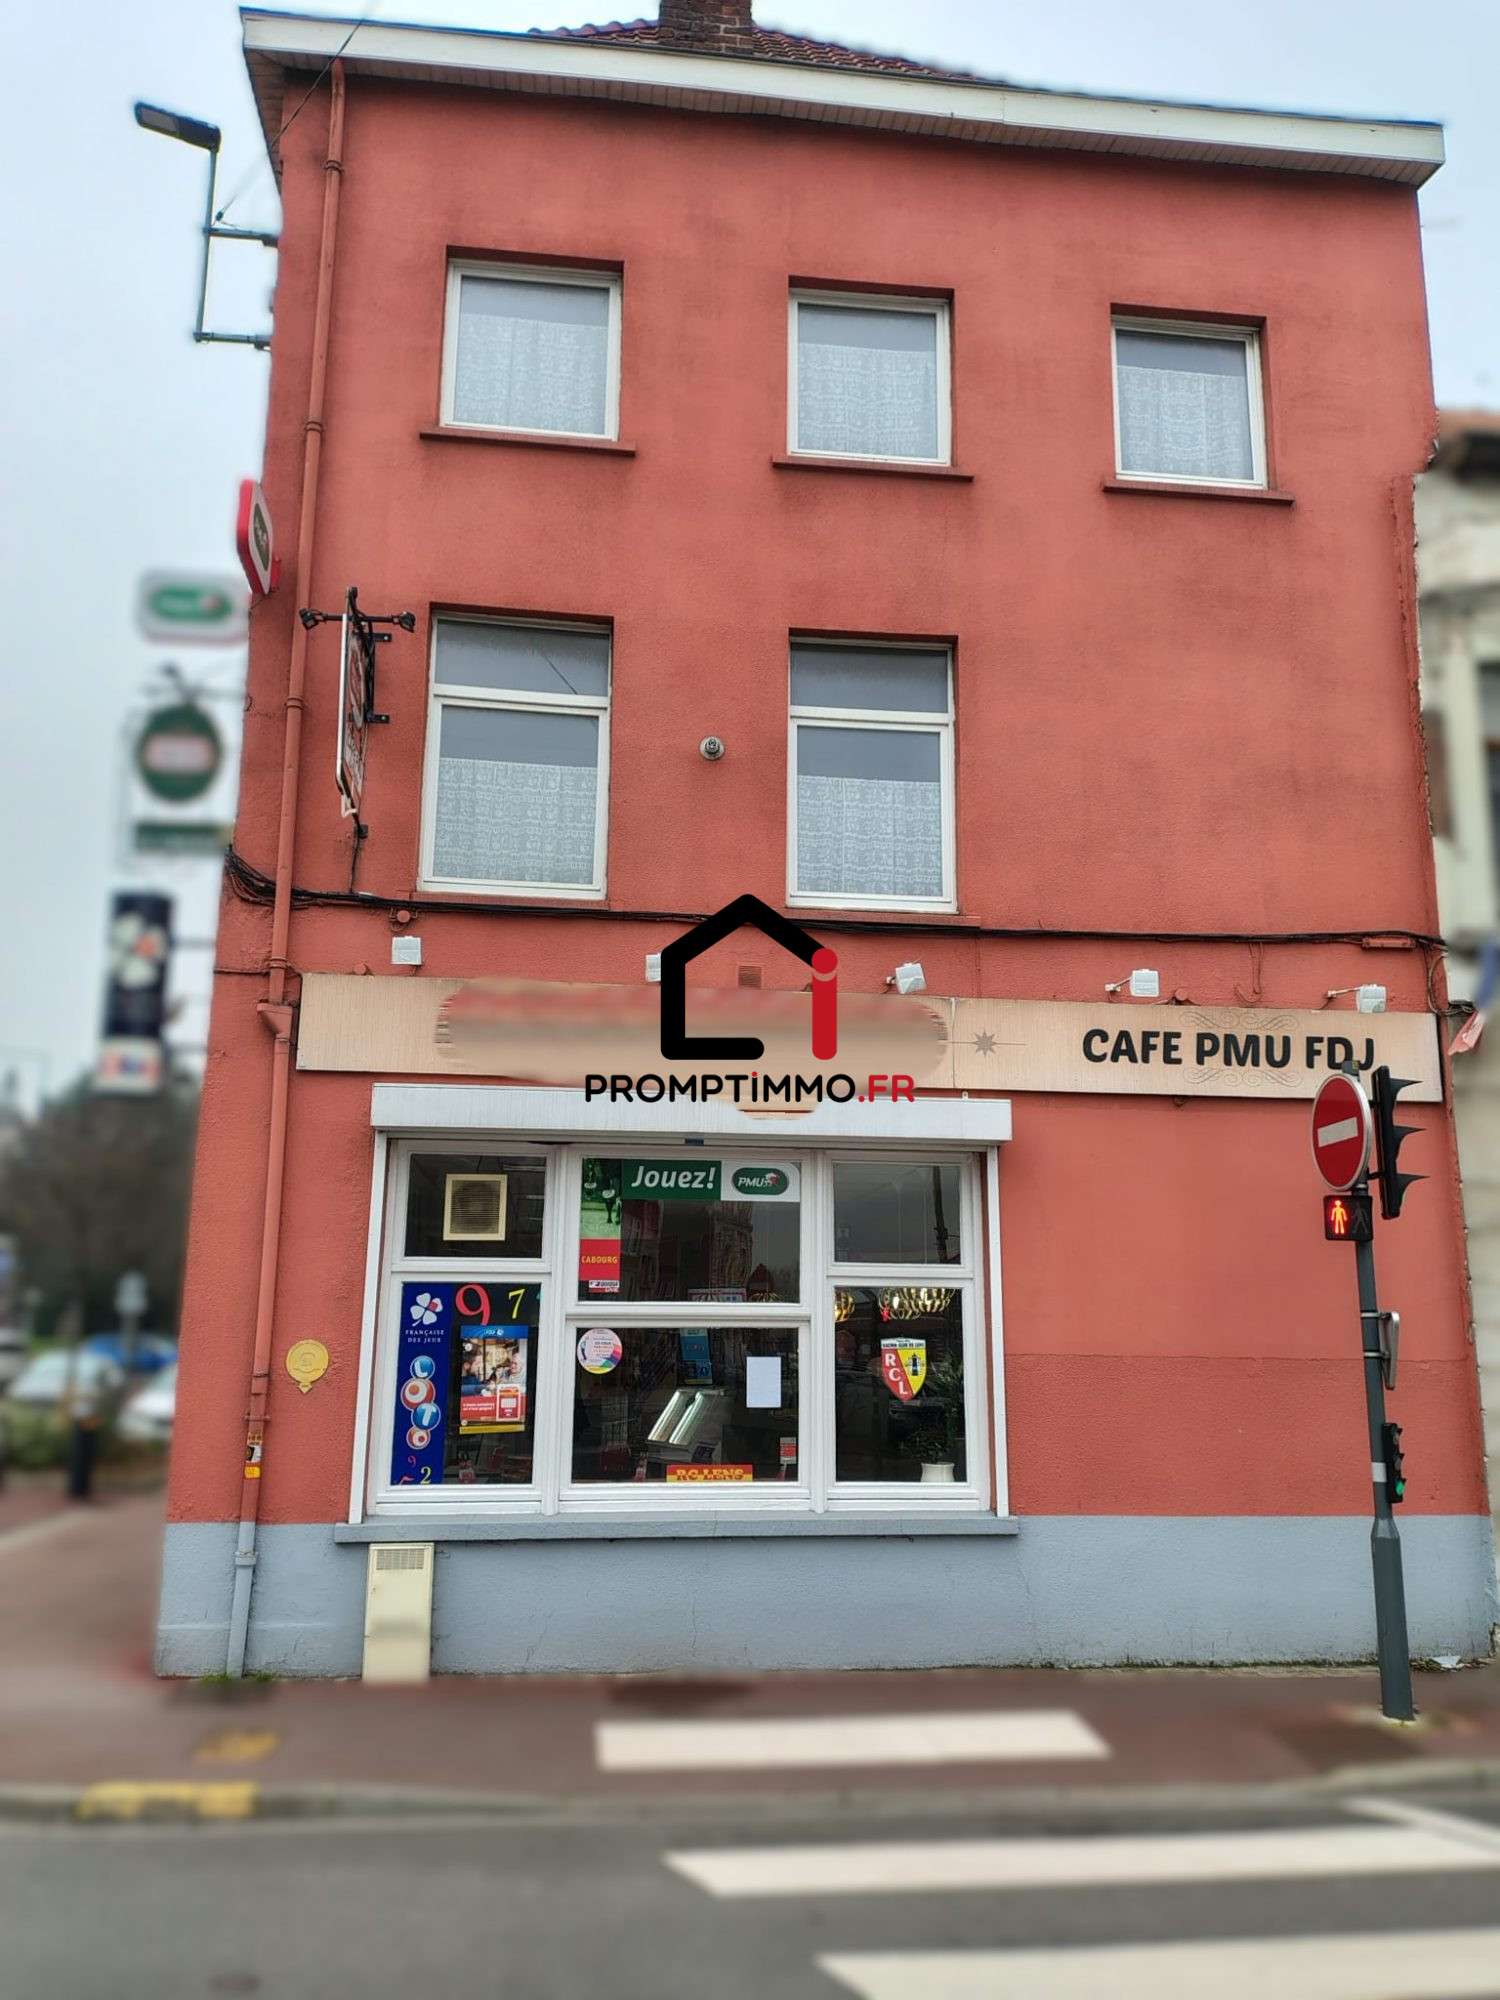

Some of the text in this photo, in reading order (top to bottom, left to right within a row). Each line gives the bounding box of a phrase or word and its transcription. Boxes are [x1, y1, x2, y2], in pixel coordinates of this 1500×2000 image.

[1082, 1028, 1375, 1071] CAFE PMU FDJ
[631, 1165, 717, 1190] Jouez!
[737, 1176, 763, 1188] PMU
[581, 1255, 618, 1265] CABOURG
[508, 1288, 526, 1319] 7
[703, 1467, 744, 1480] LENS
